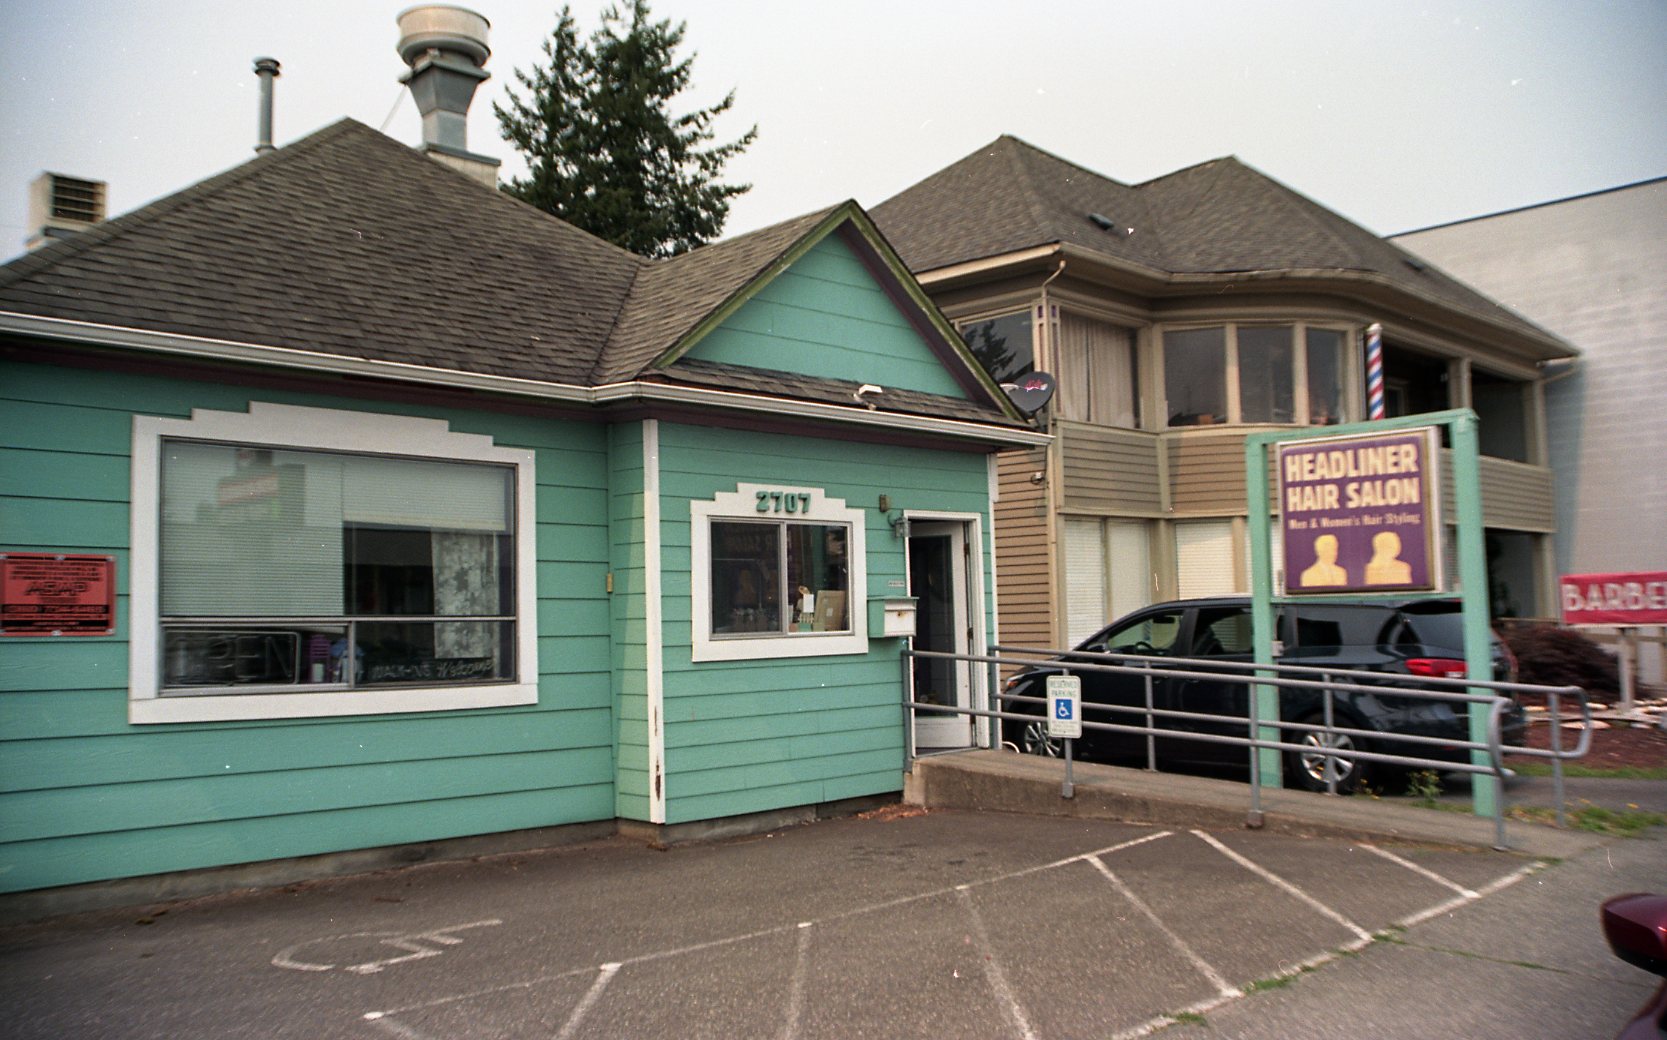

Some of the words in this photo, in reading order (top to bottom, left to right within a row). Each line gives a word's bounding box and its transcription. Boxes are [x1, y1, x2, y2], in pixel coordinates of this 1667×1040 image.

[1285, 443, 1418, 482] HEADLINER
[755, 490, 811, 514] 2707
[1287, 484, 1340, 512] HAIR
[1346, 477, 1421, 508] SALON
[1289, 519, 1308, 529] Men
[1310, 518, 1318, 528] &
[1362, 514, 1382, 525] Hair
[1384, 512, 1420, 525] Styling
[1562, 582, 1667, 611] BARBE
[1049, 680, 1078, 688] RESERVED
[1051, 689, 1077, 697] PARKING
